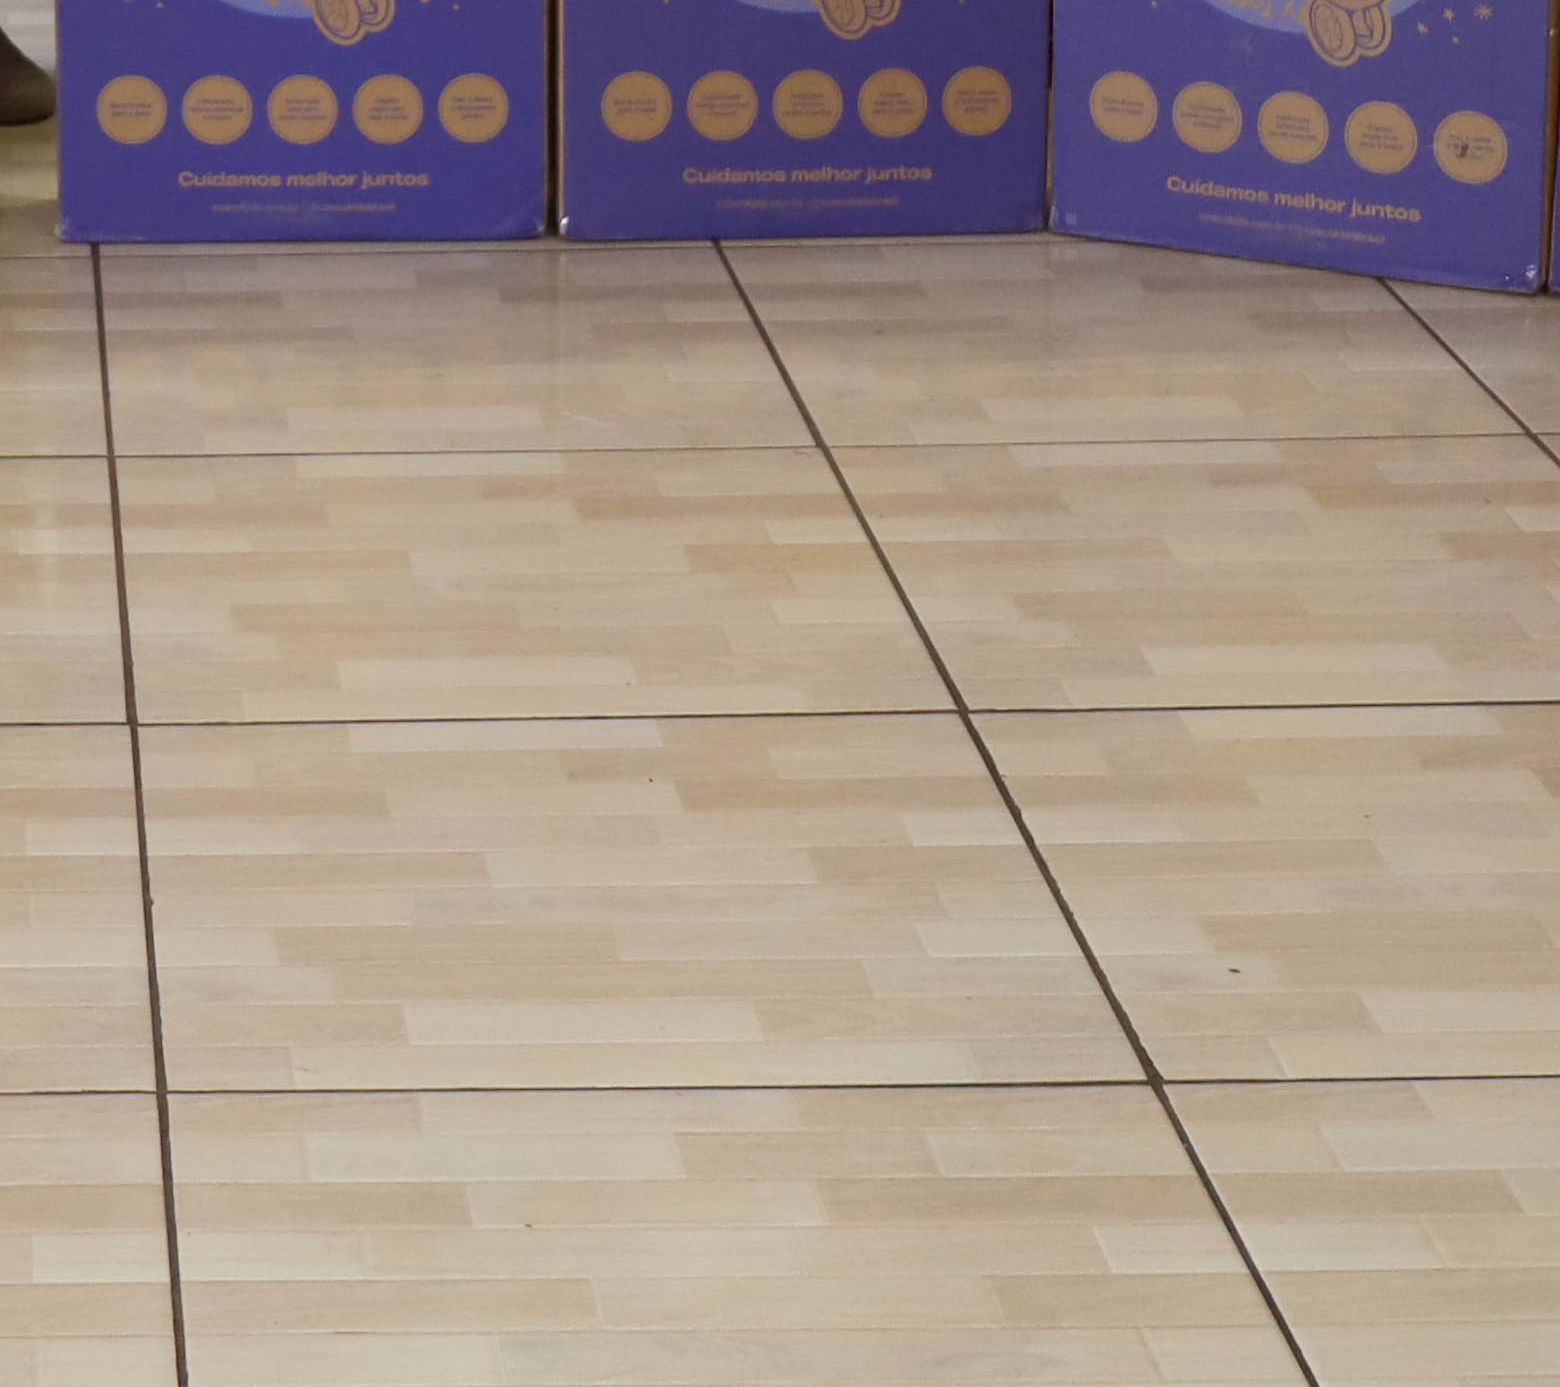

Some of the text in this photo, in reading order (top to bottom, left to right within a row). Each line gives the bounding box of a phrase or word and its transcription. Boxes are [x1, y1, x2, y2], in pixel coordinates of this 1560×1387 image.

[178, 170, 429, 190] Cuidamos melhor juntos
[683, 165, 932, 184] Cuidamos melhor juntos
[1167, 176, 1421, 223] Cuidamos melhor juntos
